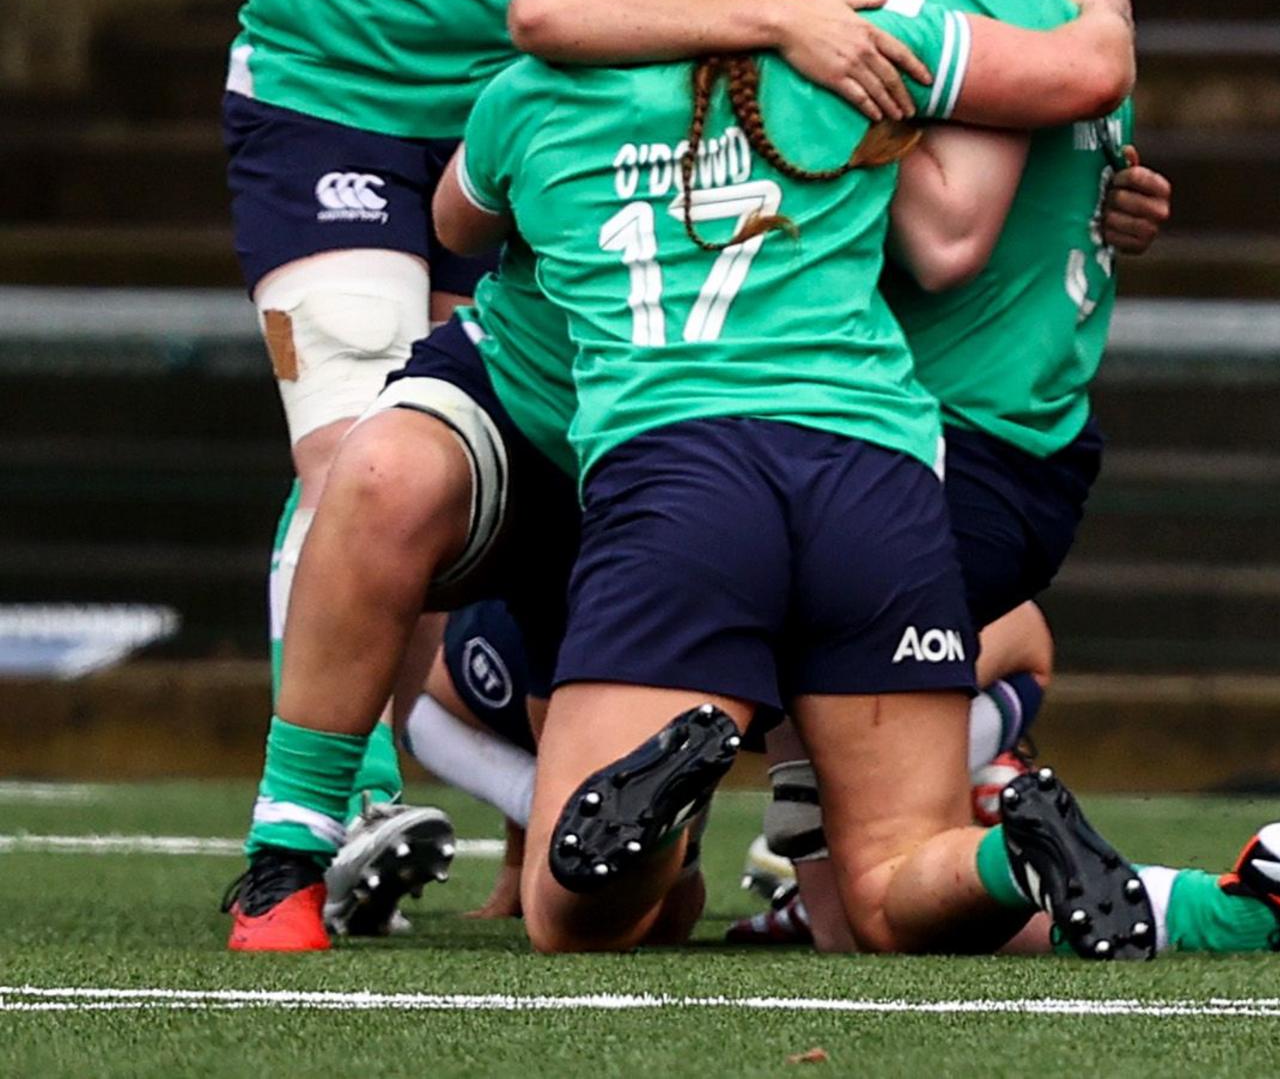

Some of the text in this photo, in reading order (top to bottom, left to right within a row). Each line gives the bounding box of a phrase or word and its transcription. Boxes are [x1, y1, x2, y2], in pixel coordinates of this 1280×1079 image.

[612, 125, 752, 200] O'DOWD
[598, 179, 783, 348] 17
[891, 624, 966, 664] AON
